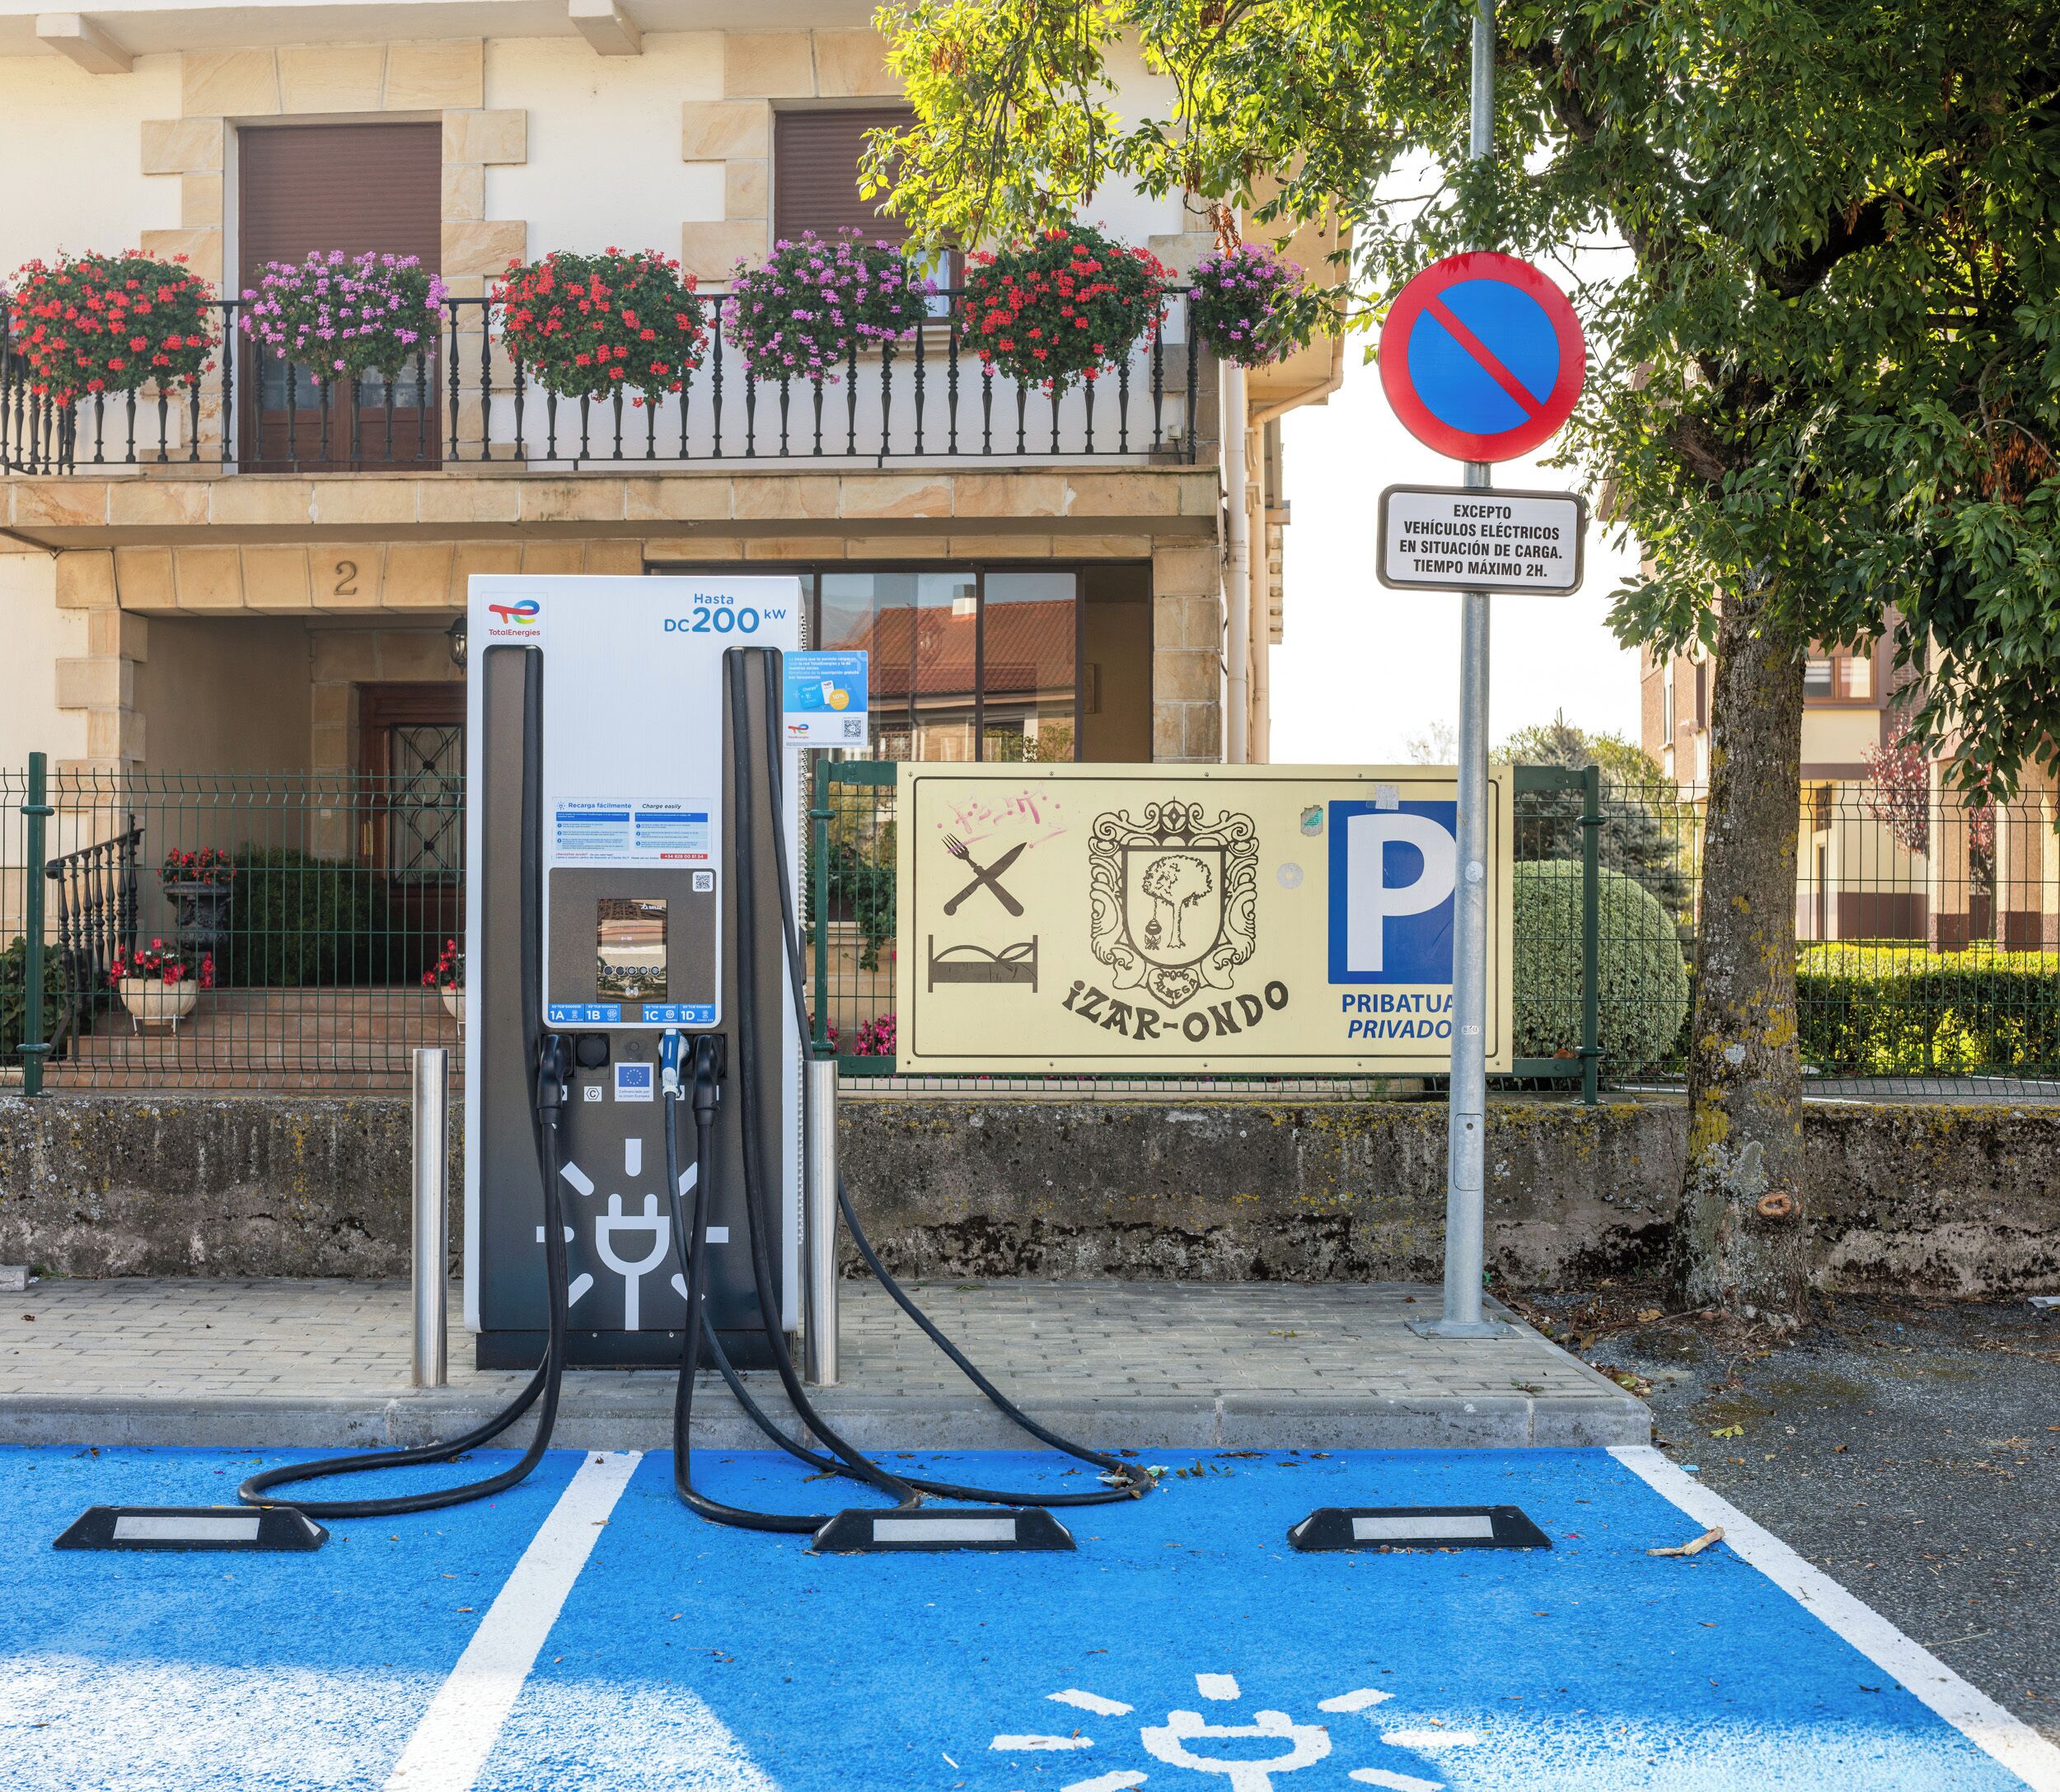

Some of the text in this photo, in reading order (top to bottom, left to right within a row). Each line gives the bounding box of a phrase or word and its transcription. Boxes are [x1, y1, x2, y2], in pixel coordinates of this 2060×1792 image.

[1454, 504, 1511, 519] EXCEPTO
[1404, 519, 1560, 540] VEHÍCULOS ELÉCTRICOS
[1399, 539, 1563, 559] EN SITUACIÓN DE CARGA.
[333, 560, 358, 596] 2
[1413, 559, 1547, 578] TIEMPO MÁXIMO 2H.
[694, 593, 734, 605] Hasta
[664, 606, 786, 633] DC 200 kW
[489, 629, 541, 637] TotalEnergies
[1347, 813, 1456, 971] P
[1341, 994, 1453, 1013] PRIBATUA
[550, 1010, 564, 1021] 1A
[586, 1010, 601, 1021] 1B
[644, 1010, 658, 1021] 1C
[681, 1010, 695, 1021] 1D
[1347, 1019, 1452, 1039] PRIVADO
